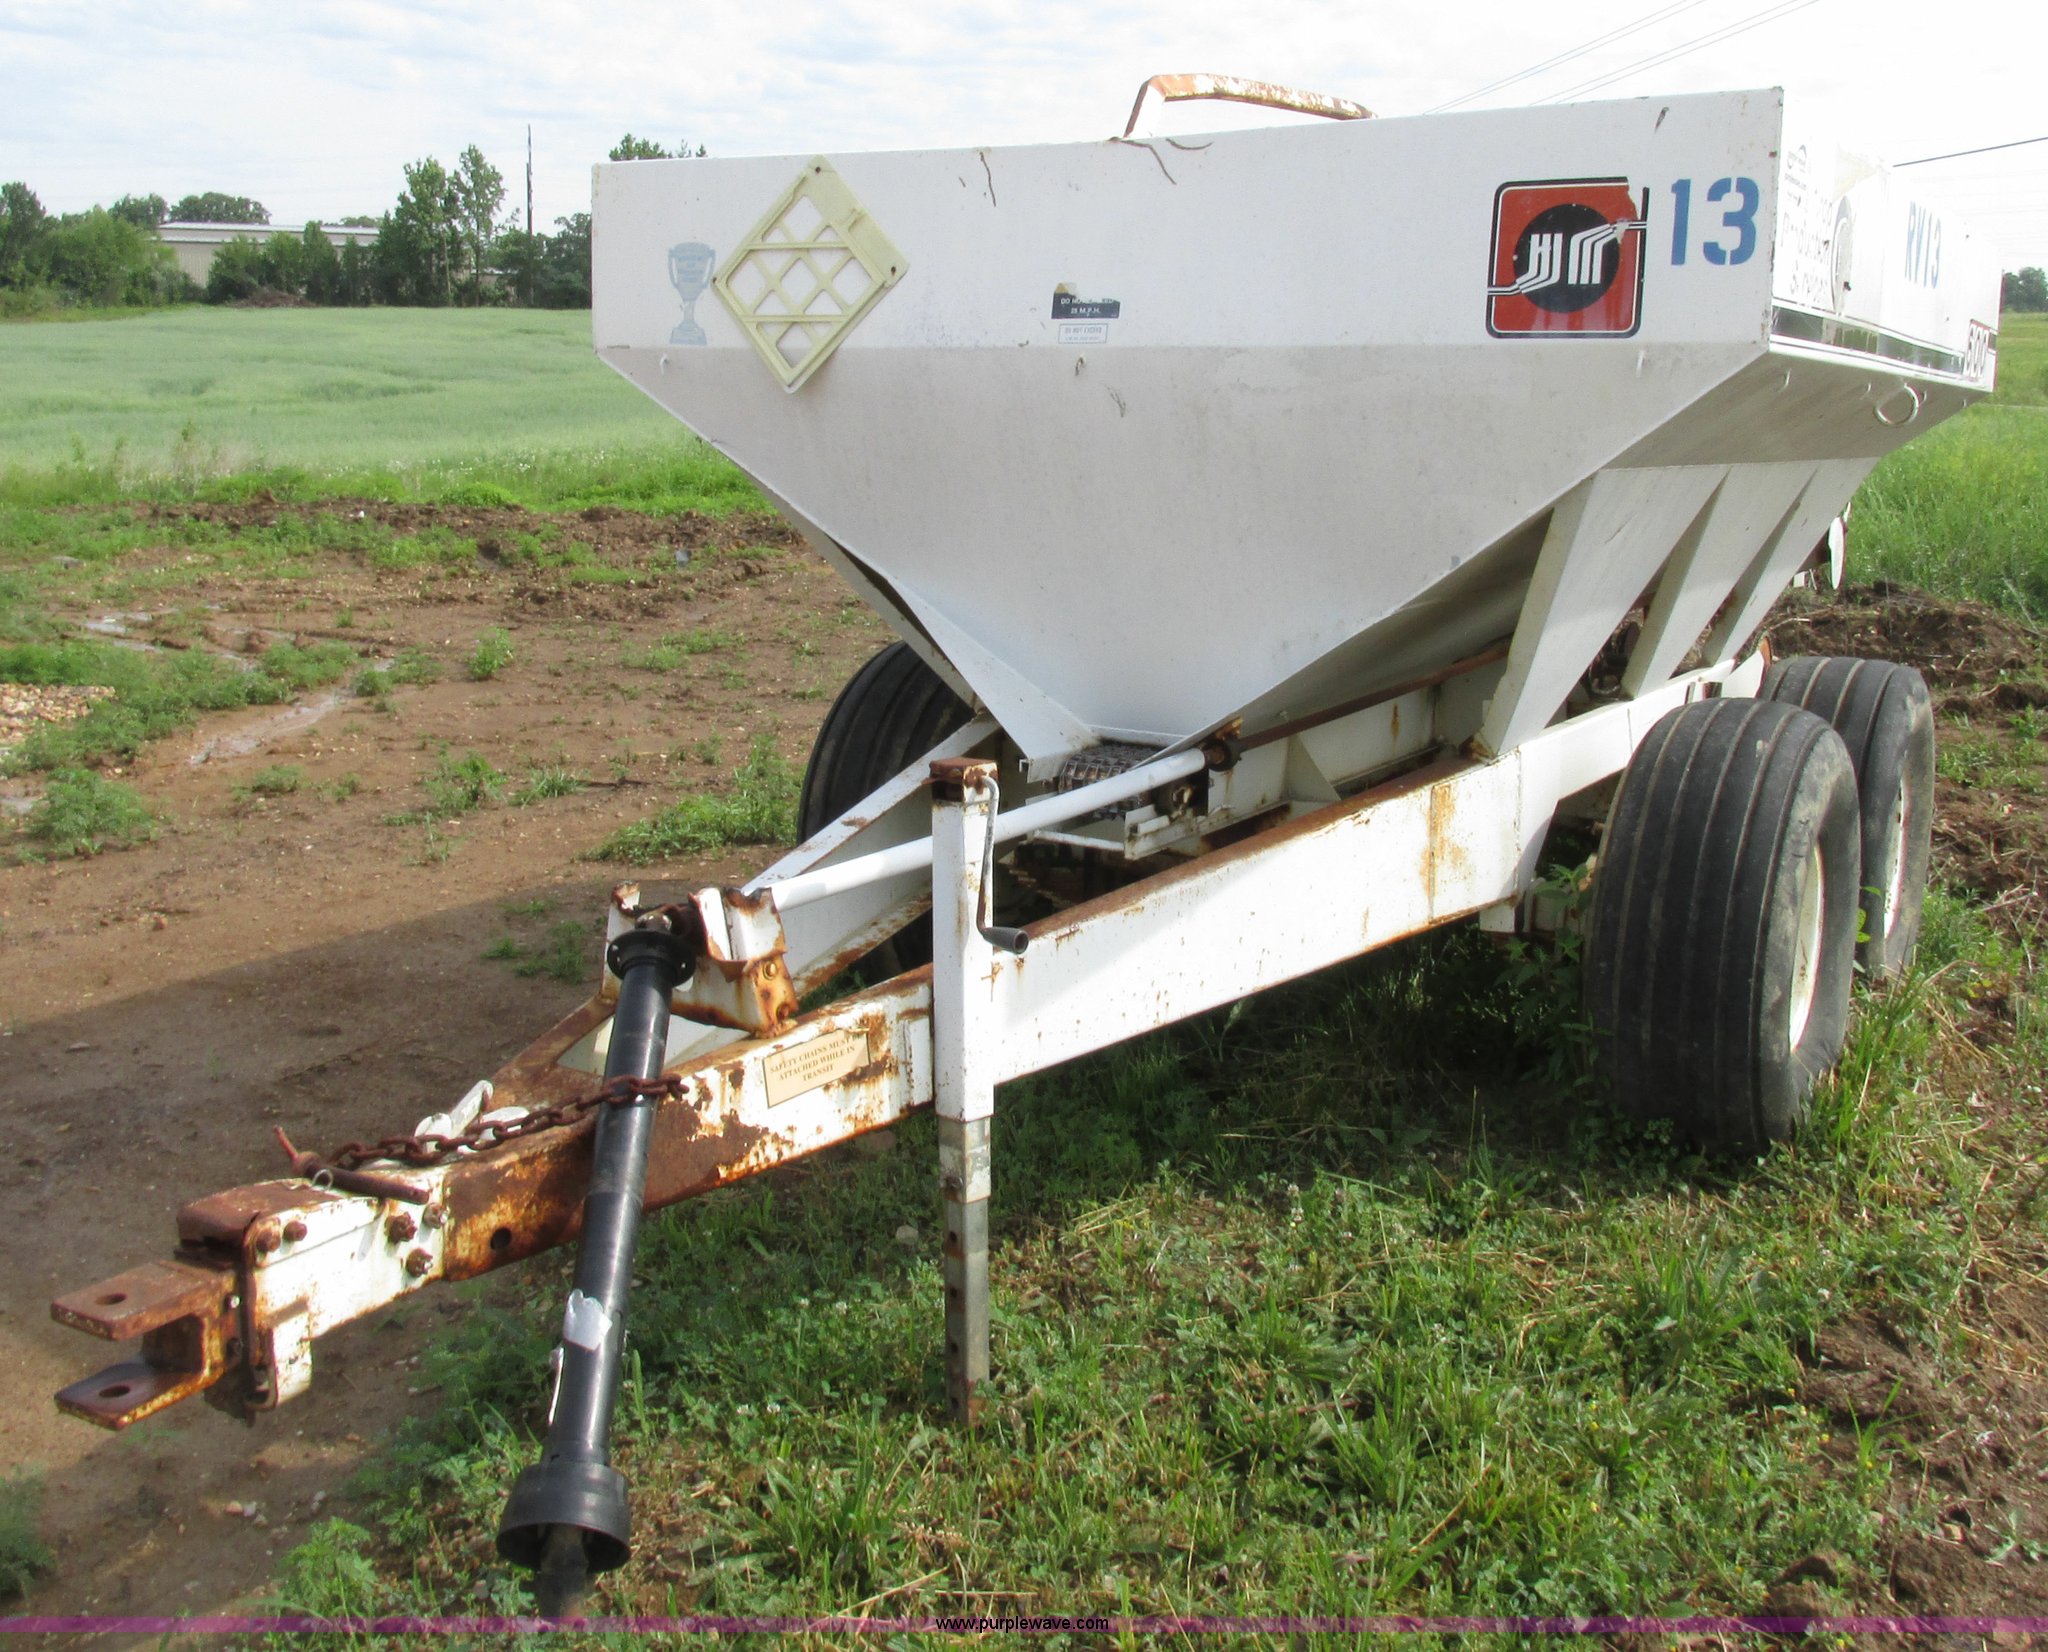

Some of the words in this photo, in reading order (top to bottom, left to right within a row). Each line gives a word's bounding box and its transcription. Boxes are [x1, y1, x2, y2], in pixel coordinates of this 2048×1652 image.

[1671, 177, 1760, 266] 13
[1905, 200, 1942, 289] RV13
[770, 1056, 798, 1074] SAFETY
[799, 1045, 828, 1062] CHAINS
[829, 1036, 851, 1050] MUST
[778, 1060, 819, 1081] ATTACHED
[821, 1050, 845, 1066] WHILE
[847, 1046, 856, 1054] IN
[802, 1064, 834, 1082] TRANSIT
